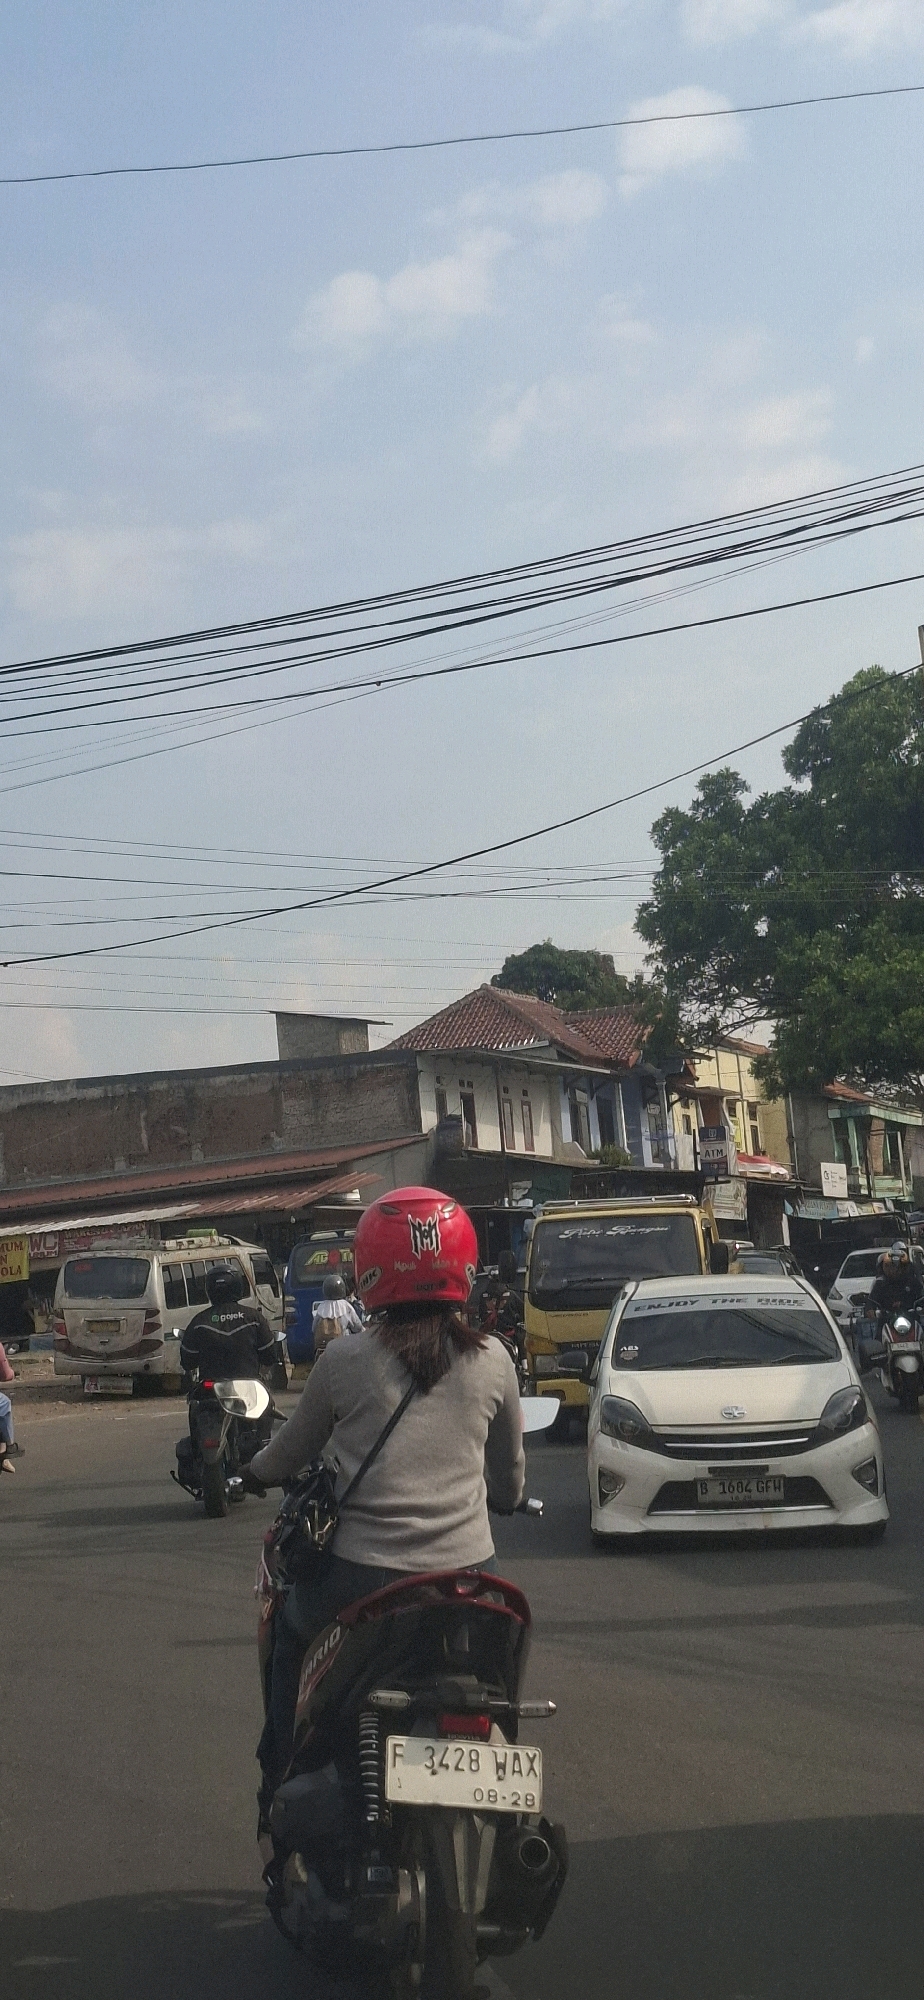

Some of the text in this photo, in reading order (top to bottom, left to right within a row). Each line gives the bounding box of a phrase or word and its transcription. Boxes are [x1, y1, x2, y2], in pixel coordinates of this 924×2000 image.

[704, 1149, 724, 1158] ATM
[30, 1231, 58, 1251] WC
[634, 1300, 699, 1312] ENJOY
[220, 1311, 245, 1322] gojek
[700, 1481, 708, 1495] B
[757, 1479, 781, 1493] GFW
[393, 1743, 538, 1778] F 3428 WAX
[473, 1787, 535, 1807] 08-28
